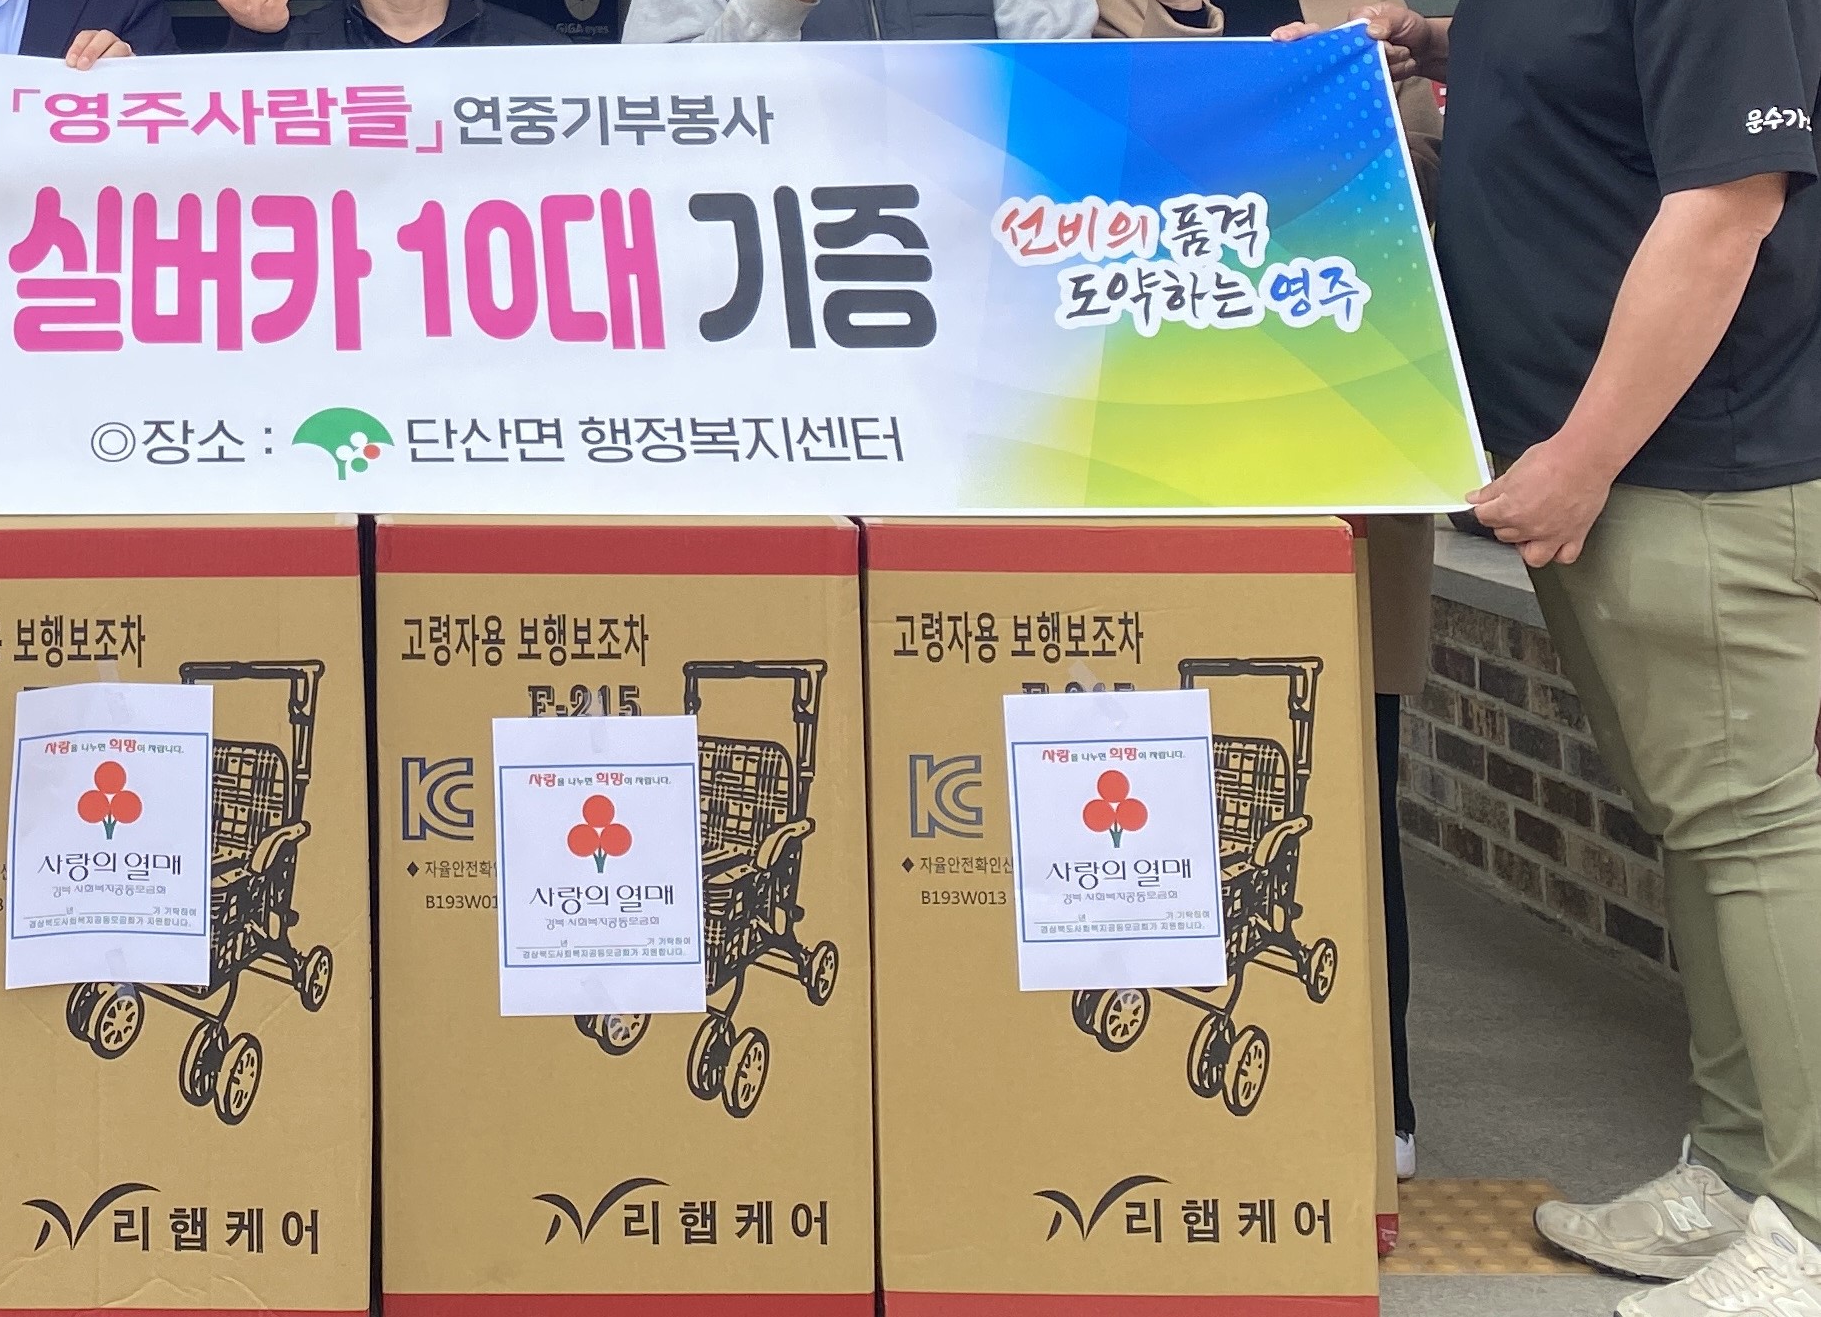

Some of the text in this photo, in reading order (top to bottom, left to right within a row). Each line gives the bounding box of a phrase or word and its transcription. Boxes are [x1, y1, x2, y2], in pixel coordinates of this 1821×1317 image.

[1001, 202, 1259, 259] 선비의 품격
[7, 184, 373, 353] 실버카
[396, 187, 666, 350] 10대
[688, 183, 938, 349] 기증
[1066, 267, 1360, 326] 도약하는 영주
[406, 416, 565, 465] 단산면
[579, 415, 905, 465] 행정복지센터
[13, 614, 146, 668] 보행보조차
[402, 613, 649, 667] 고령자용 보행보조차
[893, 611, 1143, 664] 고령자용 보행보조차
[528, 684, 641, 717] F-215
[401, 757, 474, 841] KC
[909, 754, 983, 838] KC
[37, 851, 182, 882] 사랑의 열매
[1046, 858, 1191, 890] 사랑의 열매
[529, 885, 674, 915] 사랑의 열매
[921, 890, 1007, 905] B193W013
[111, 1204, 321, 1255] 리햅케어
[623, 1197, 830, 1247] 리햅케어
[1124, 1197, 1333, 1247] 리햅케어
